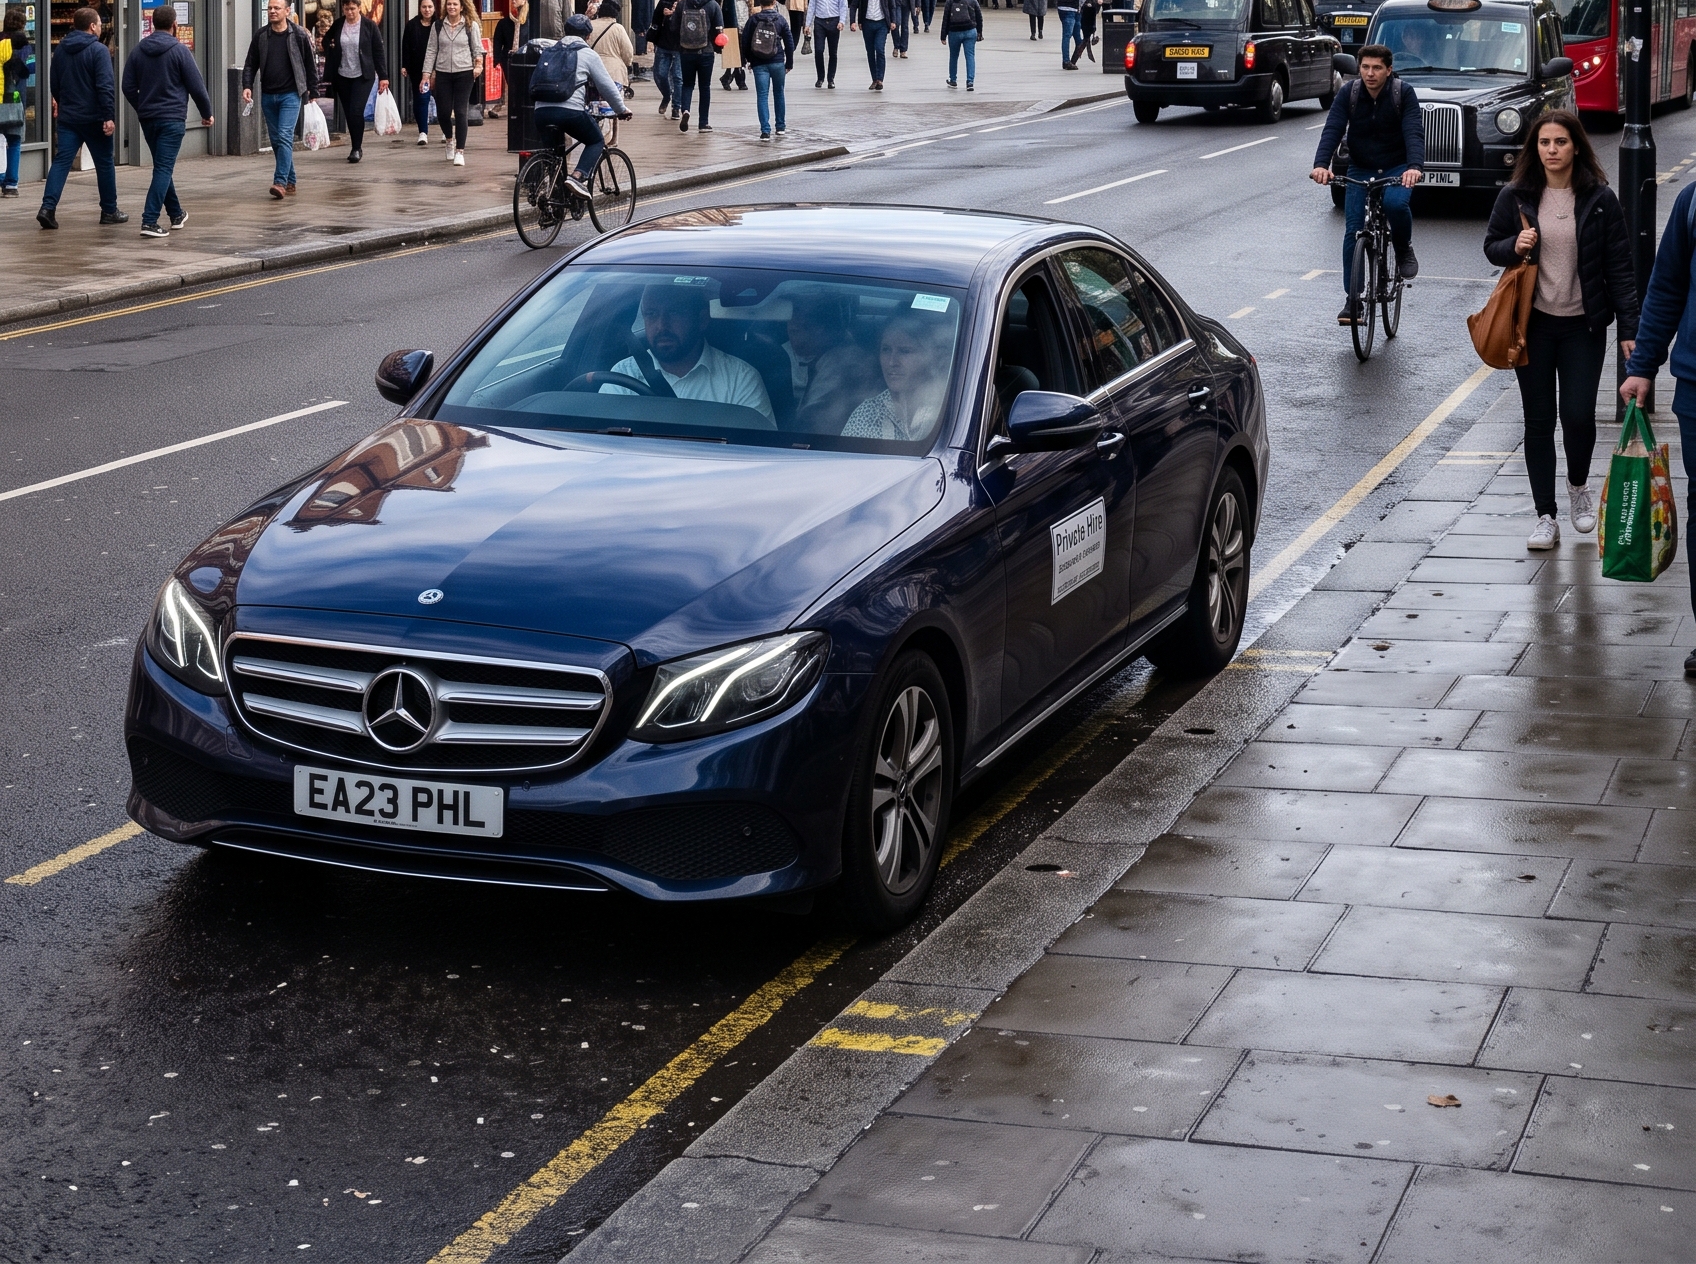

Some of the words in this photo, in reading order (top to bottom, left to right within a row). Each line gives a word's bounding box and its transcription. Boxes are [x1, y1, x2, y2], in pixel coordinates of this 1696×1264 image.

[1056, 523, 1085, 556] Private
[1086, 513, 1103, 537] Hire
[309, 772, 399, 819] EA23
[411, 786, 486, 828] PHL
